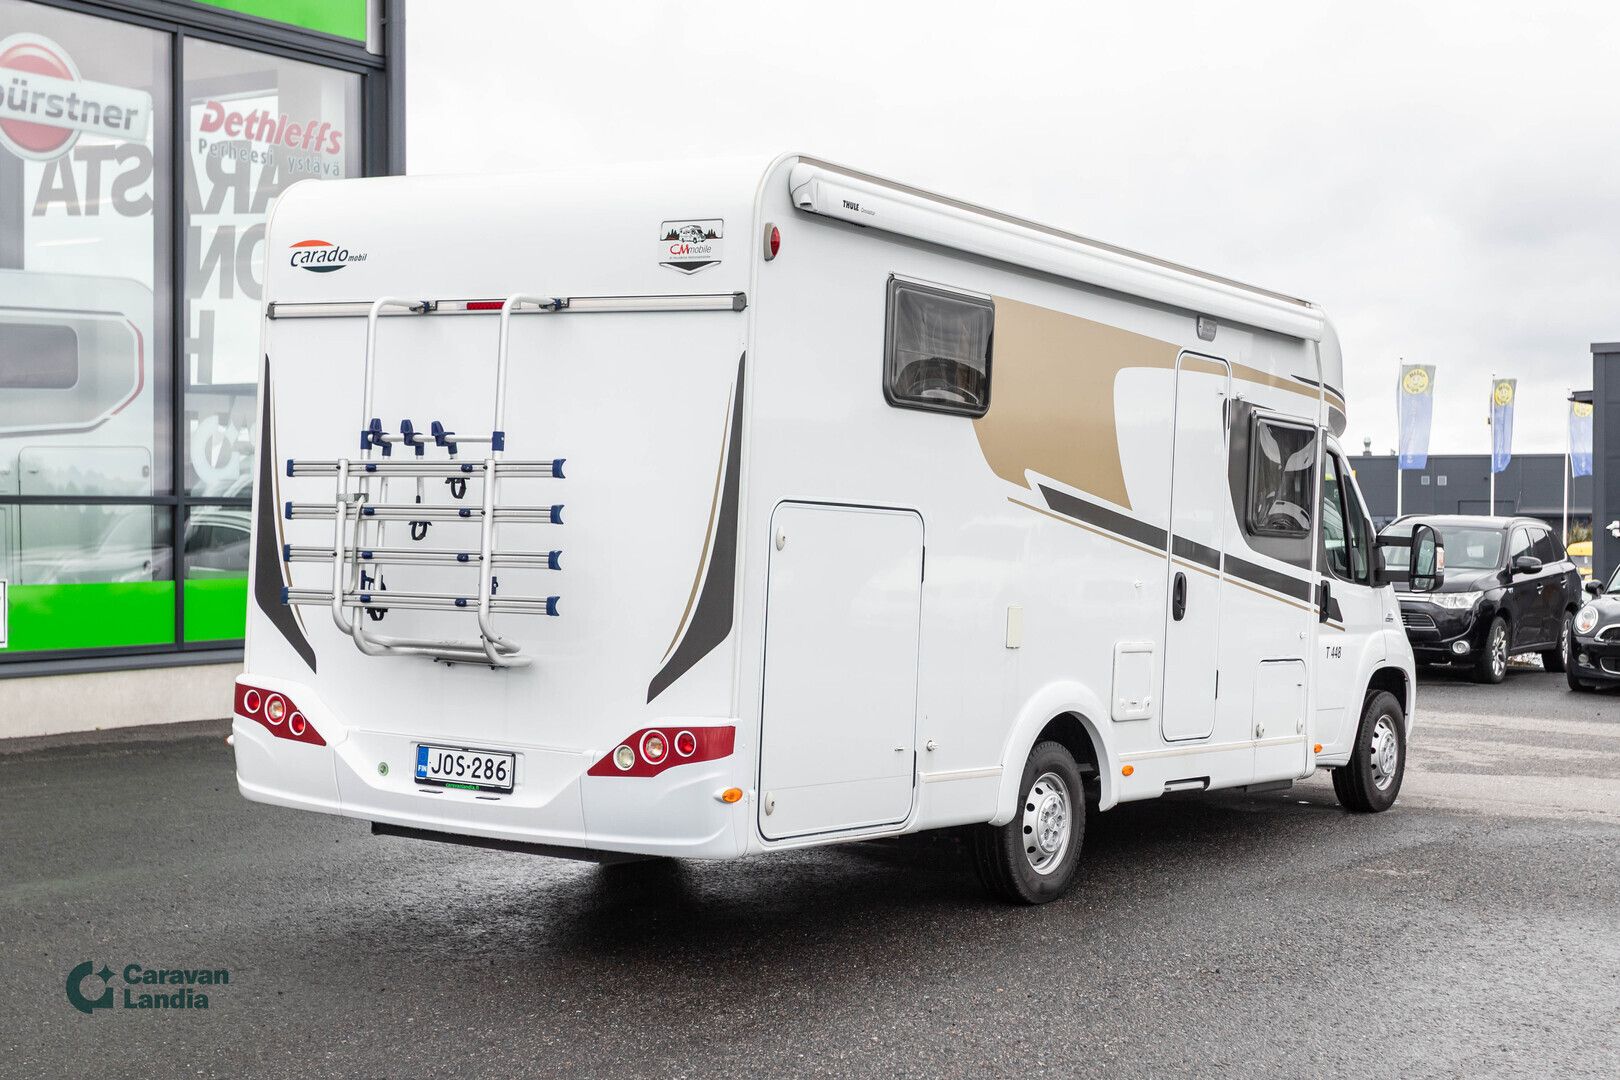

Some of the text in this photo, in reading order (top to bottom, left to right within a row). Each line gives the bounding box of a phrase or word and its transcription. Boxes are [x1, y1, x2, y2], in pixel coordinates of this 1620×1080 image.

[0, 78, 138, 130] ürstner
[199, 100, 343, 155] Dethleffs
[198, 138, 340, 177] Perheesi ystävä
[842, 199, 859, 212] THULE
[290, 245, 349, 267] carado
[431, 752, 507, 781] JOS-286
